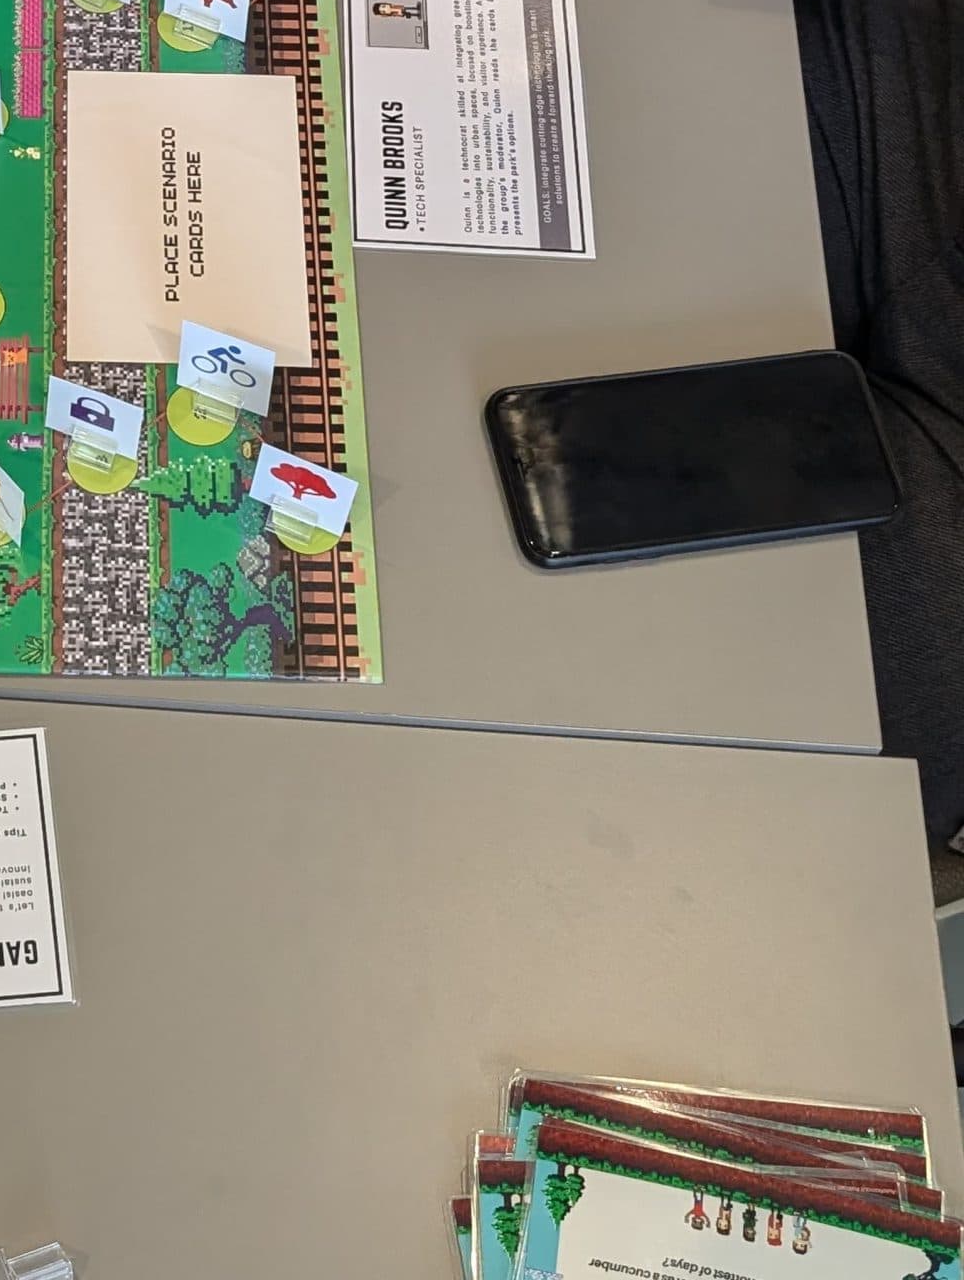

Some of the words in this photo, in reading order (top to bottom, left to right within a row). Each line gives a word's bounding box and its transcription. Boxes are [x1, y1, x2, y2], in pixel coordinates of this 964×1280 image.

[453, 24, 465, 67] integrating
[456, 90, 466, 117] skilled
[381, 100, 404, 169] BROOKS
[458, 125, 469, 170] technocrat
[160, 127, 178, 226] SCENARIO
[186, 151, 202, 202] HERE
[412, 126, 424, 190] SPECIALIST
[383, 175, 409, 230] QUINN
[415, 193, 425, 224] TECH
[462, 206, 472, 232] Quinn
[188, 210, 204, 276] CARDS
[163, 234, 180, 301] PLACE
[3, 825, 26, 837] Tips
[587, 1257, 651, 1280] cucumber
[661, 1254, 698, 1274] days?
[698, 1265, 711, 1277] of
